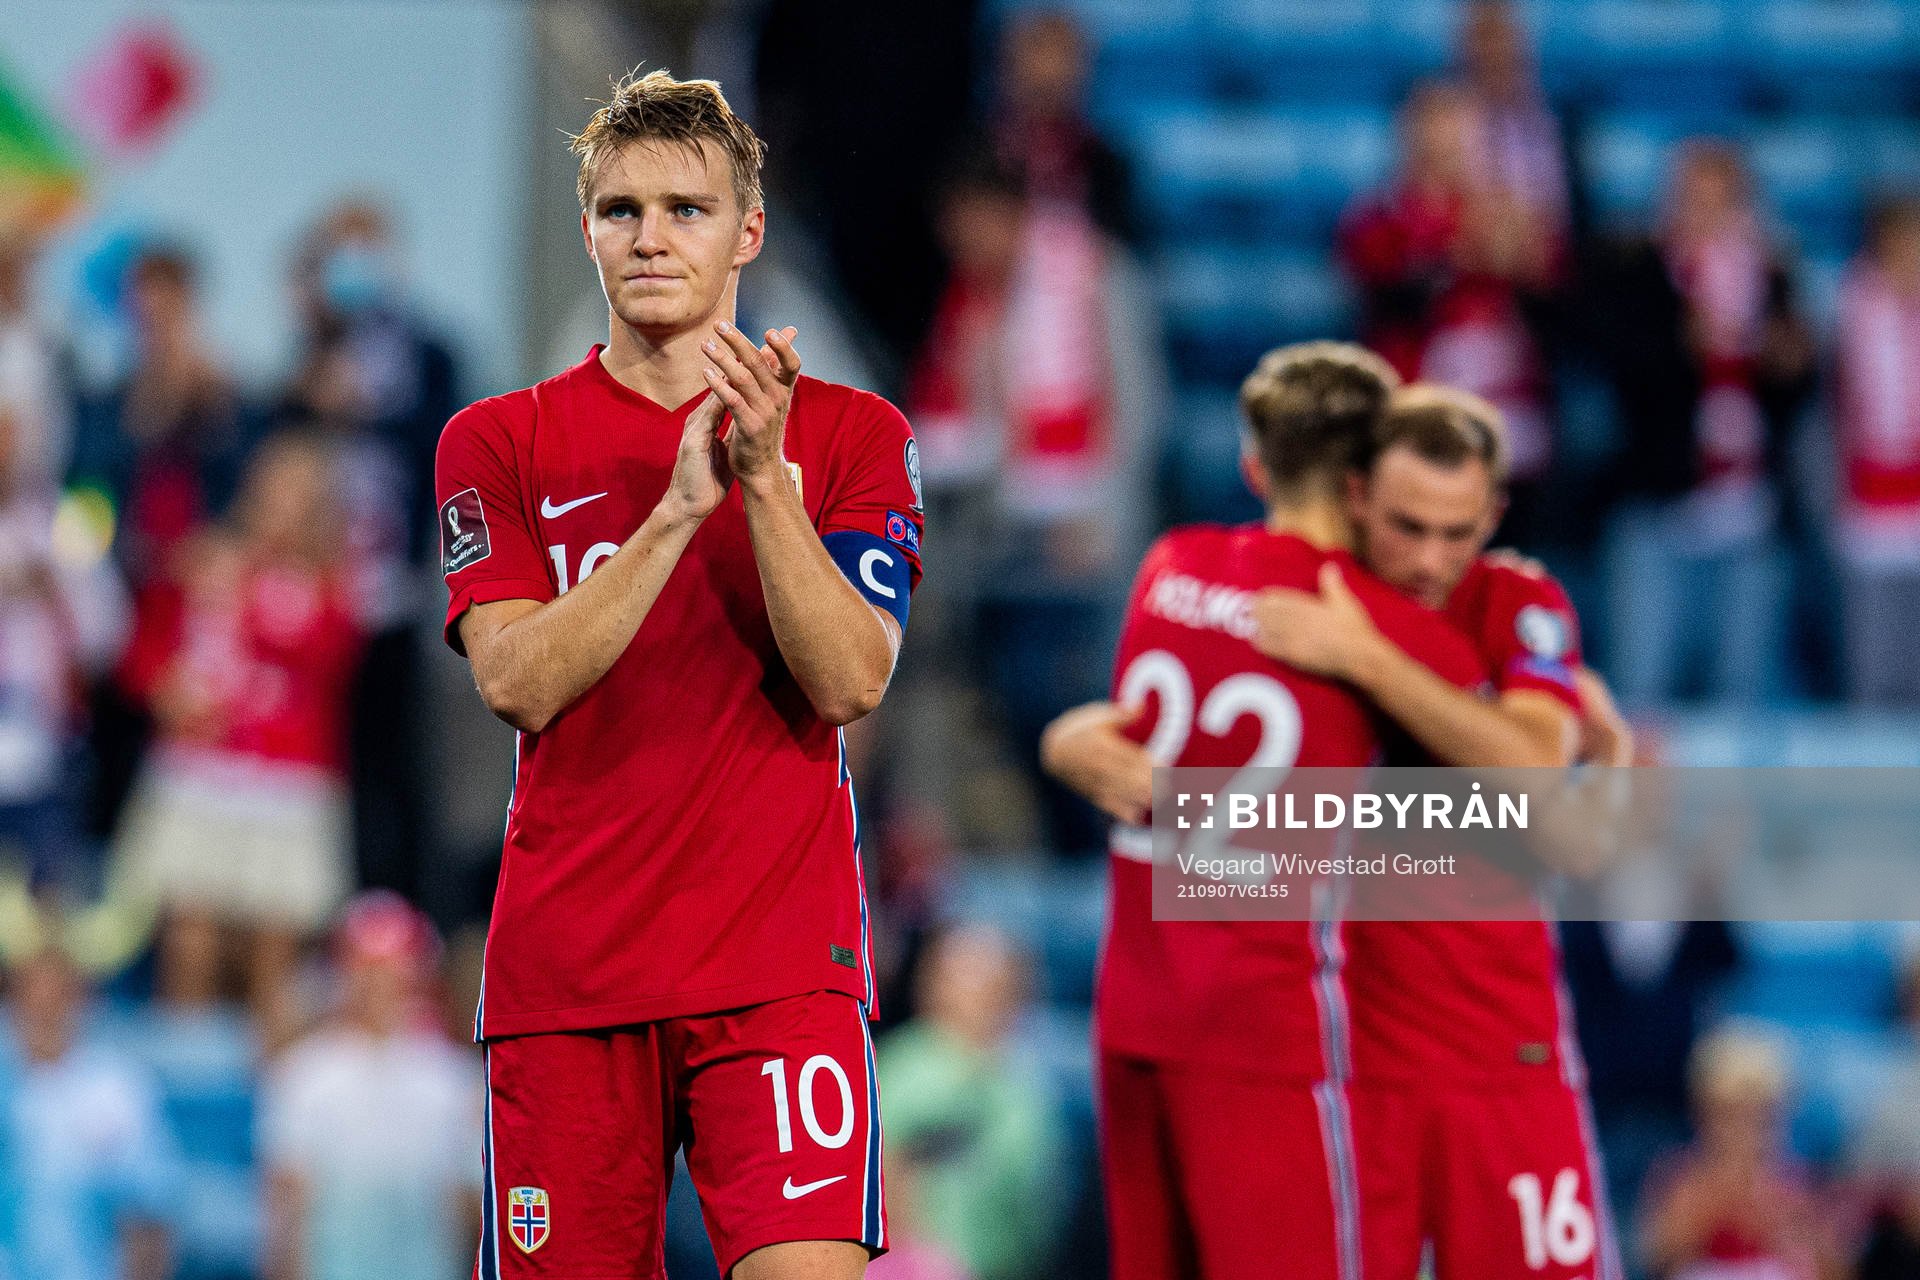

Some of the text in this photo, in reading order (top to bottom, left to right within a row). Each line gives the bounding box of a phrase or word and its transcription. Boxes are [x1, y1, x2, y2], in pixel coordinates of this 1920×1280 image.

[859, 548, 896, 599] C
[1108, 649, 1303, 884] 22
[760, 1054, 855, 1154] 10
[1507, 1166, 1595, 1271] 16
